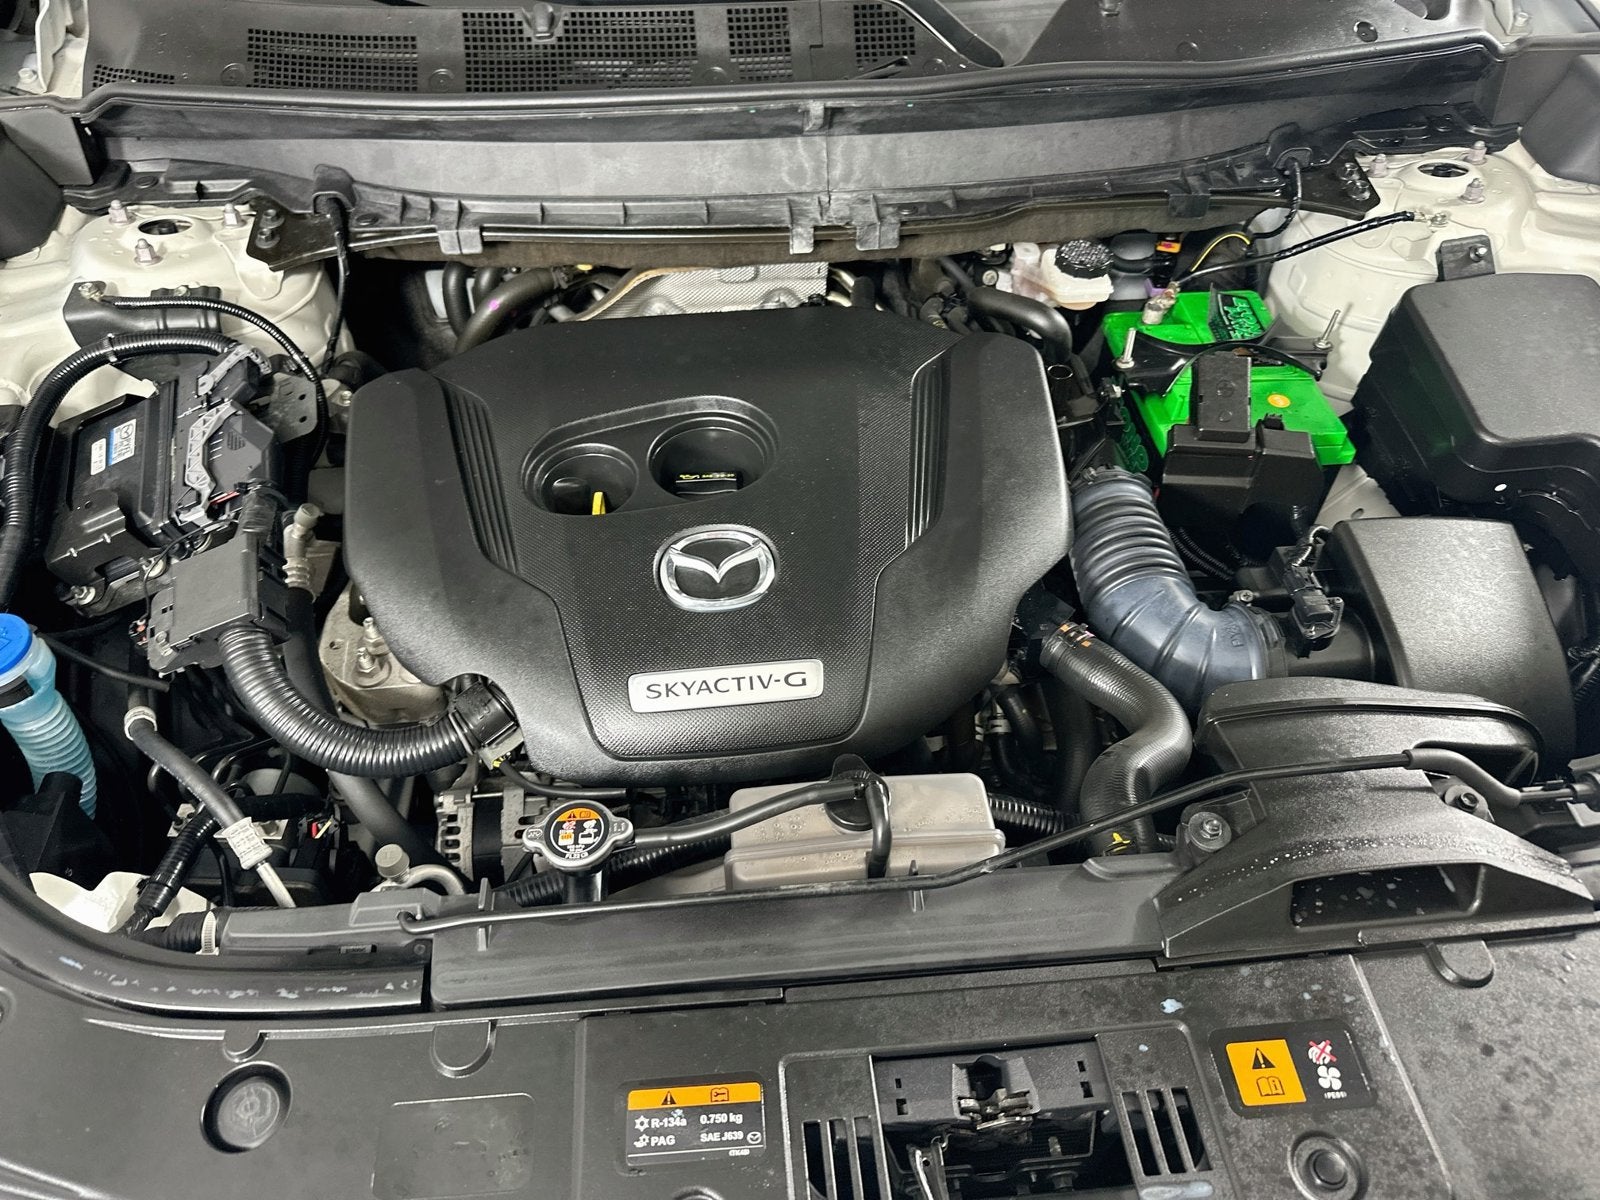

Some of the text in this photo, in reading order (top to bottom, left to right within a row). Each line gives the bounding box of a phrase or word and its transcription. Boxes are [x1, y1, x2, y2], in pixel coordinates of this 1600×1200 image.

[645, 671, 807, 699] SKYACTIV-G
[651, 1112, 743, 1129] R-134a 0.750 kg
[651, 1131, 744, 1147] PAG SAE J639
